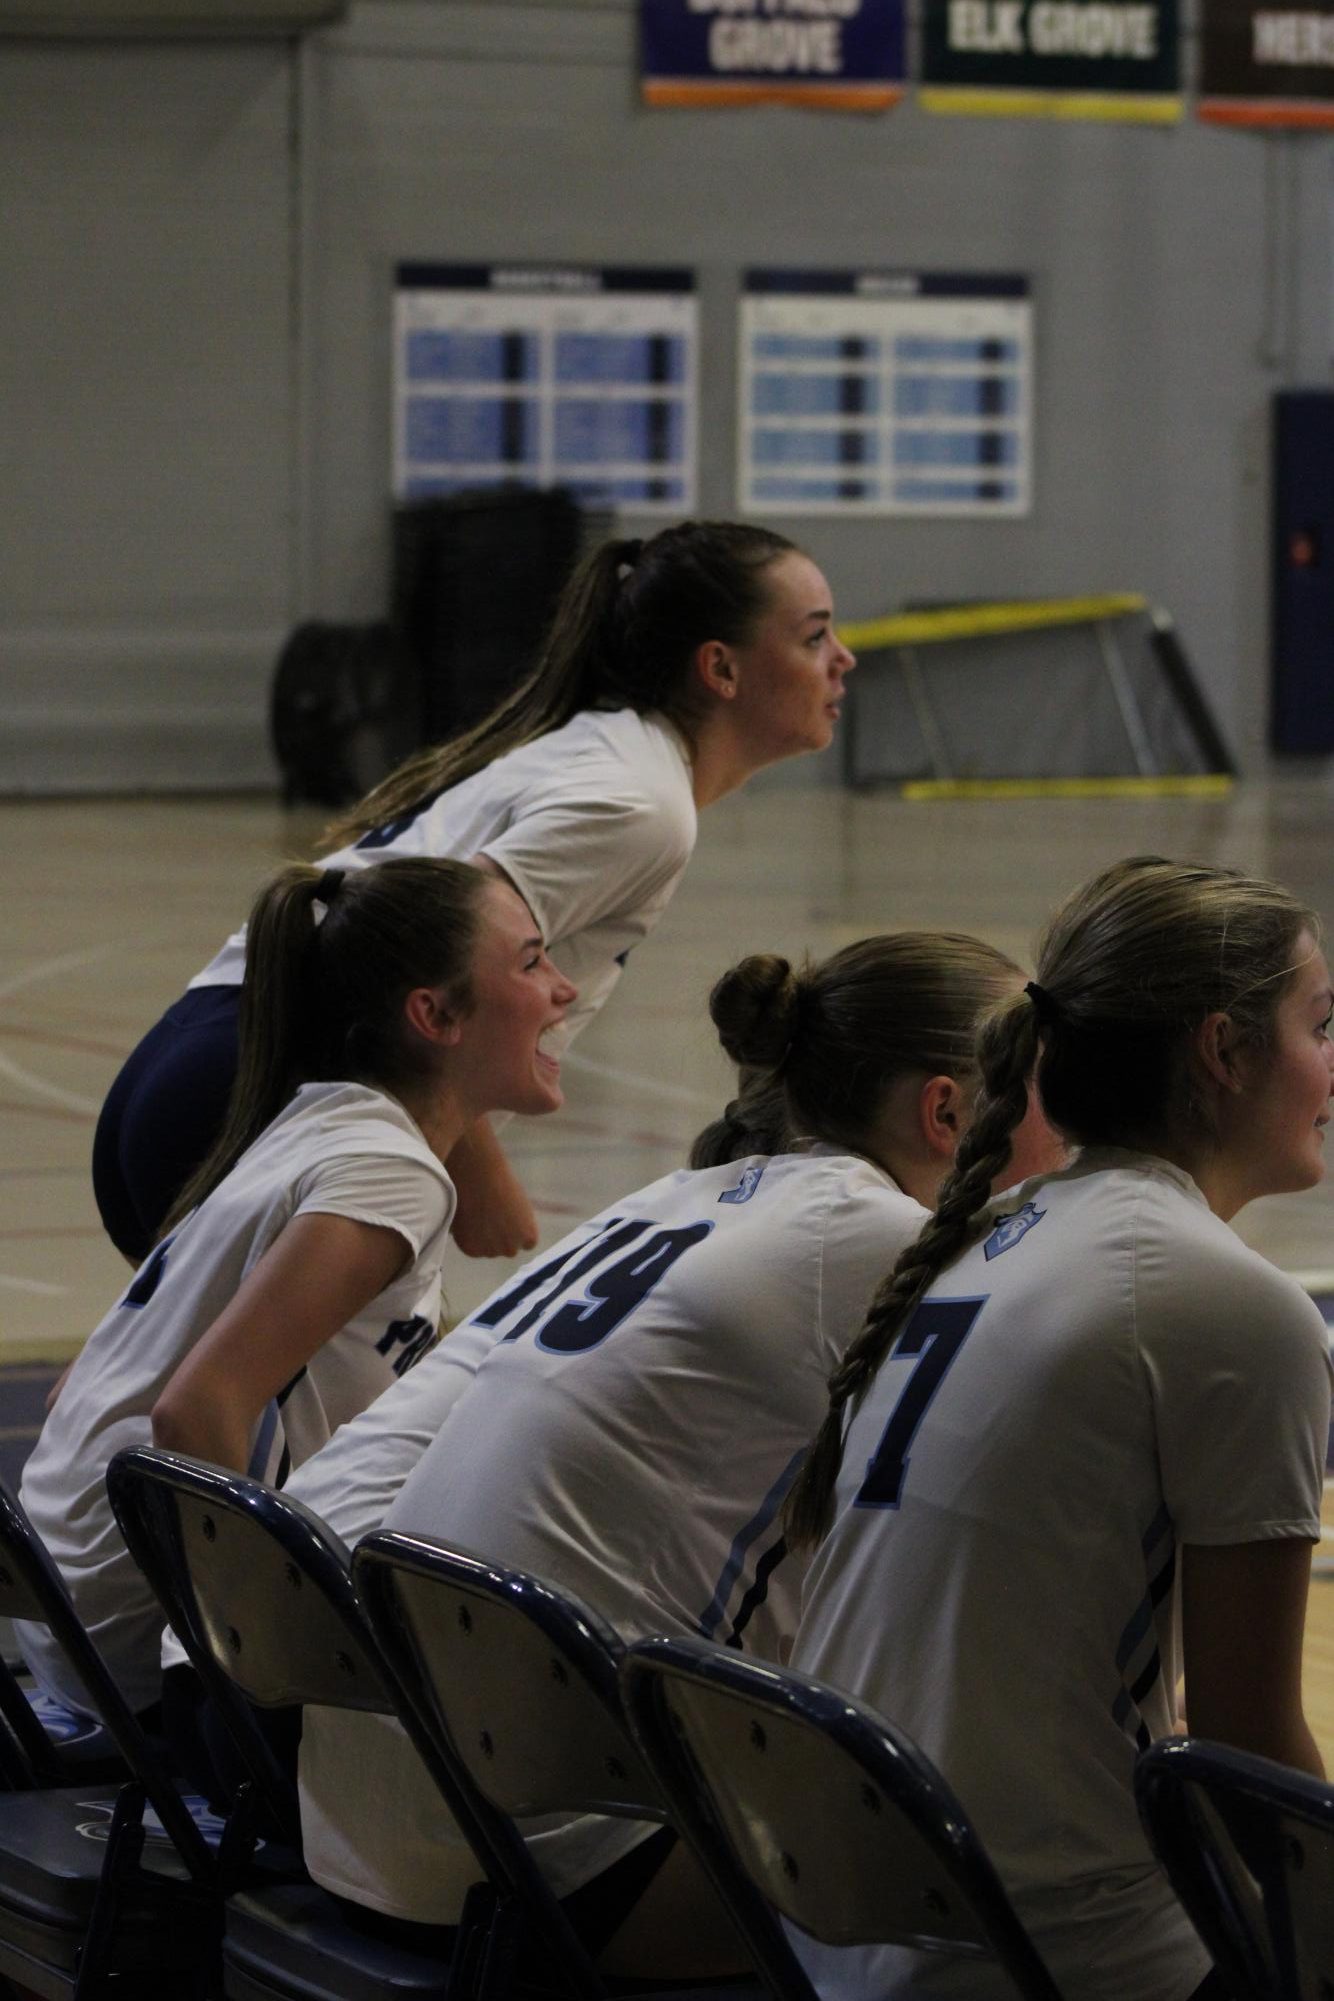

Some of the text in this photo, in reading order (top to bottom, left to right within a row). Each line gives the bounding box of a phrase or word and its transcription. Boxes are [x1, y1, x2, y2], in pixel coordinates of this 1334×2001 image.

[709, 18, 842, 73] GROVE
[946, 1, 1158, 61] ELK GROVE
[853, 1293, 991, 1510] 7
